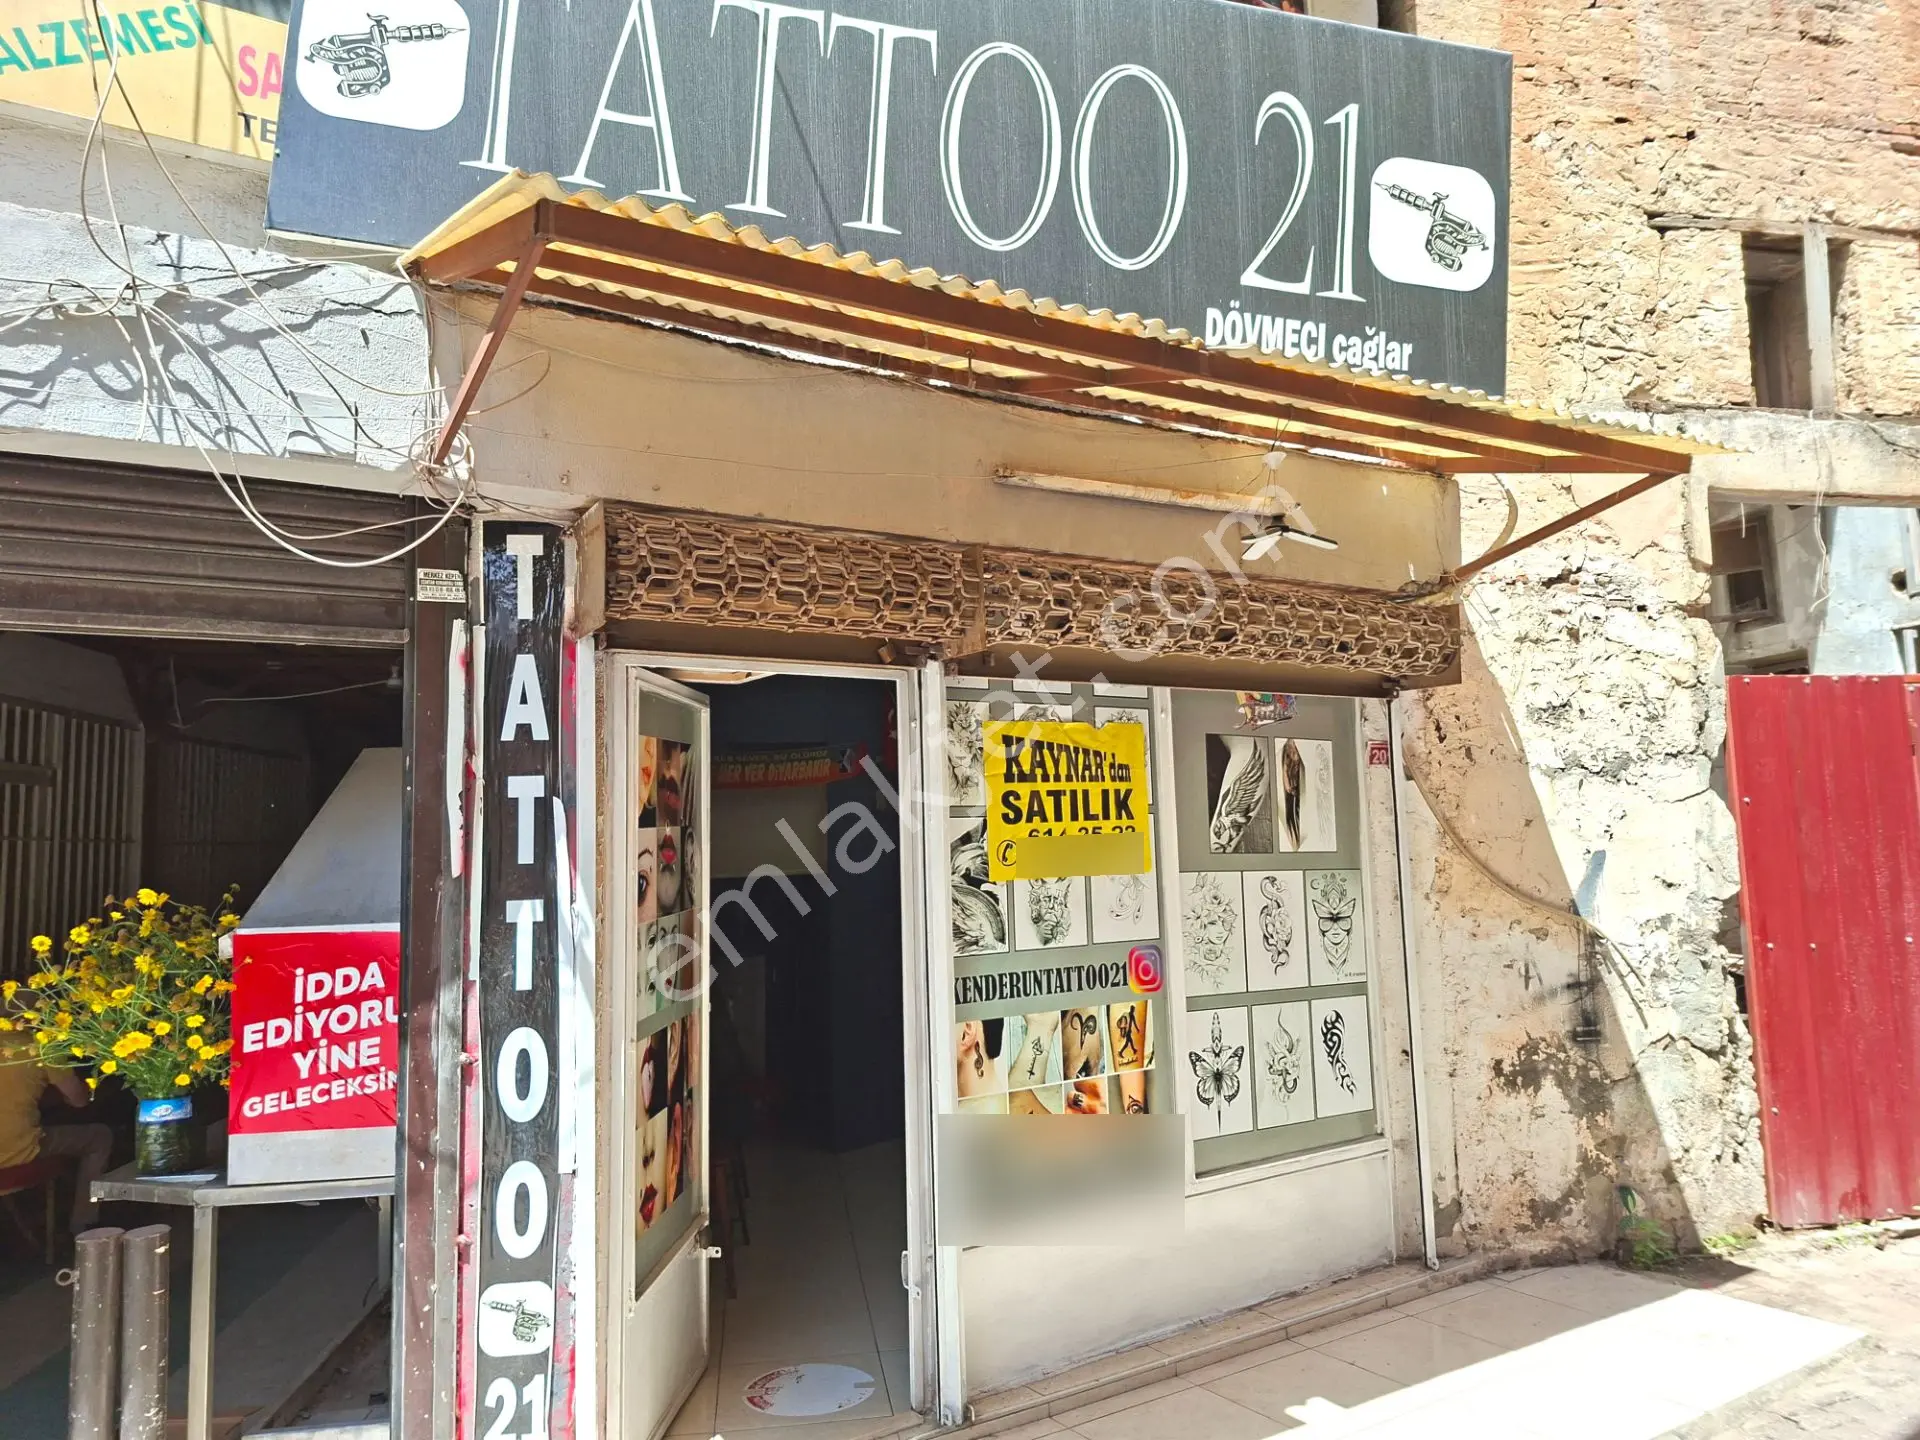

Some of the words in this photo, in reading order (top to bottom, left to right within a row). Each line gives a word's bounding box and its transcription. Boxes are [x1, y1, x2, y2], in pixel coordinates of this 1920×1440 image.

[460, 0, 1189, 271] TATTOO
[1239, 91, 1368, 303] 21
[1372, 749, 1387, 764] 20
[1001, 788, 1135, 825] SATILIK
[496, 534, 549, 1260] TATTOO
[294, 961, 386, 1005] İDDA
[292, 1038, 382, 1081] YİNE
[483, 1373, 547, 1440] 21
